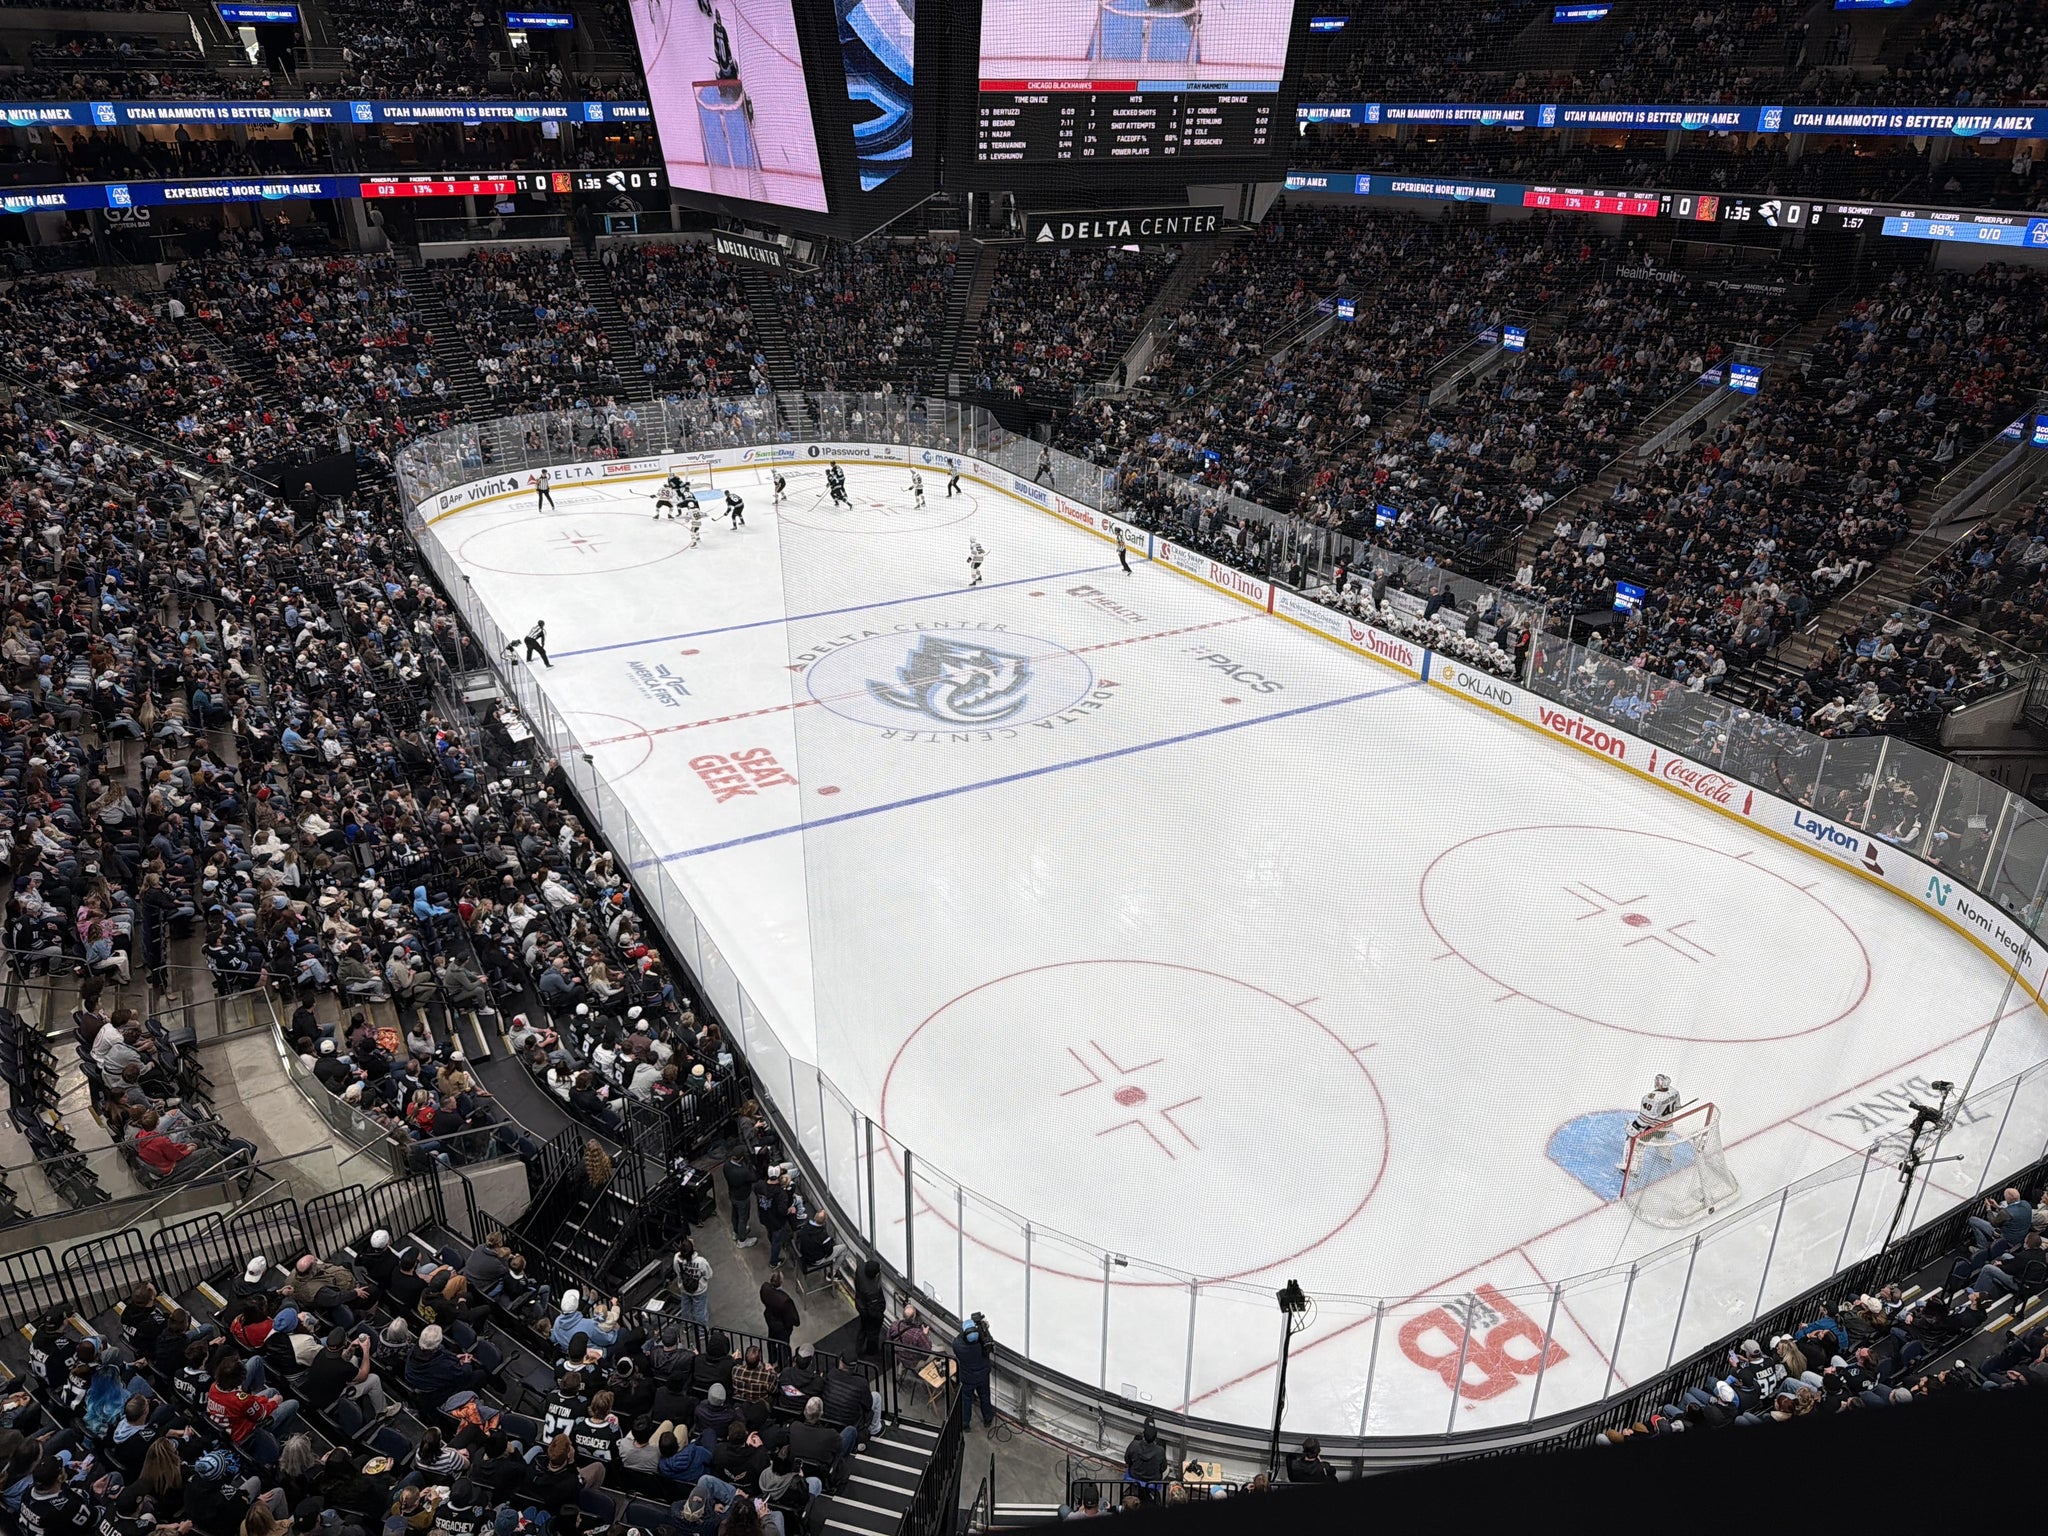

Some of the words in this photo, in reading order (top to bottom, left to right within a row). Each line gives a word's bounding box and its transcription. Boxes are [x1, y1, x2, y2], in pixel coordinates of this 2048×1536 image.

[8, 109, 38, 120] WITH
[40, 109, 72, 120] AMEX
[127, 108, 156, 119] UTAH
[158, 108, 215, 119] MAMMOTH
[218, 108, 229, 118] IS
[232, 108, 271, 118] BETTER
[273, 108, 301, 118] WITH
[303, 108, 332, 118] AMEX
[383, 108, 410, 117] UTAH
[413, 108, 463, 117] MAMMOTH
[466, 108, 476, 117] IS
[479, 108, 513, 117] BETTER
[515, 108, 539, 117] WITH
[542, 108, 568, 117] AMEX
[613, 108, 636, 117] UTAH
[1310, 109, 1328, 117] WITH
[1330, 109, 1351, 118] AMEX
[1387, 109, 1406, 118] UTAH
[1407, 109, 1444, 119] MAMMOTH
[1446, 109, 1453, 118] IS
[1455, 110, 1481, 119] BETTER
[1482, 110, 1501, 120] WITH
[1503, 110, 1524, 120] AMEX
[1565, 111, 1586, 122] UTAH
[1588, 112, 1633, 122] MAMMOTH
[1635, 112, 1645, 122] IS
[1648, 112, 1682, 123] BETTER
[1684, 113, 1709, 123] WITH
[1711, 113, 1740, 124] AMEX
[1793, 114, 1823, 126] UTAH
[1825, 115, 1887, 127] MAMMOTH
[1889, 115, 1902, 127] IS
[1905, 116, 1953, 128] BETTER
[1957, 116, 1992, 129] WITH
[1993, 117, 2034, 130] AMEX
[518, 181, 528, 190] 11
[536, 176, 546, 190] 0
[578, 179, 601, 189] 1:35
[631, 174, 641, 187] 0
[650, 179, 657, 187] 8
[1287, 177, 1306, 186] WITH
[1307, 177, 1327, 187] AMEX
[164, 187, 229, 198] EXPERIENCE
[232, 186, 261, 196] MORE
[263, 184, 290, 194] WITH
[293, 184, 322, 194] AMEX
[378, 186, 395, 194] 0/3
[413, 185, 432, 194] 13%
[448, 185, 454, 193] 3
[494, 184, 504, 192] 17
[1392, 182, 1433, 193] EXPERIENCE
[1435, 184, 1454, 194] MORE
[1456, 186, 1474, 196] WITH
[1475, 187, 1496, 198] AMEX
[5, 196, 34, 207] WITH
[36, 194, 66, 205] AMEX
[1537, 197, 1550, 205] 0/3
[1566, 198, 1581, 207] 13%
[1594, 200, 1600, 209] 3
[1617, 202, 1623, 211] 2
[1679, 198, 1691, 215] 0
[104, 206, 150, 222] G2G
[1637, 203, 1647, 212] 17
[1661, 203, 1669, 213] 11
[1724, 206, 1751, 220] 1:35
[1787, 206, 1800, 223] 0
[1812, 214, 1819, 224] 8
[1931, 213, 1960, 221] FACEOFFS
[1061, 220, 1131, 240] DELTA
[1140, 216, 1216, 234] CENTER
[1842, 217, 1864, 228] 1:57
[1900, 222, 1908, 232] 3
[1929, 225, 1954, 236] 88%
[1979, 229, 2000, 240] 0/0
[723, 238, 750, 260] DELTA
[749, 245, 780, 268] CENTER
[822, 447, 870, 457] 1Password
[935, 455, 962, 466] moie
[607, 464, 631, 472] SME
[1014, 480, 1027, 495] BUD
[1028, 486, 1047, 503] LIGHT
[448, 493, 463, 505] App
[1060, 501, 1094, 526] Trucordia
[1109, 522, 1123, 537] Kn
[1124, 528, 1145, 547] Garff
[797, 630, 880, 662] DELTA
[893, 621, 1009, 632] CENTER
[1367, 630, 1413, 667] Smith's
[1196, 654, 1284, 694] PACS
[626, 660, 660, 689] AMERICA
[652, 686, 681, 707] FIRST
[1458, 672, 1512, 706] OKLAND
[1032, 690, 1114, 730] DELTA
[881, 728, 1018, 743] CENTER
[1540, 706, 1626, 759] verizon
[730, 747, 799, 788] SEAT
[688, 754, 758, 804] GEEK
[1793, 811, 1859, 852] Layton
[1957, 898, 1994, 933] Nomi
[1995, 926, 2032, 968] Health
[247, 1401, 260, 1415] 98
[548, 1403, 572, 1417] HAYTON
[543, 1417, 575, 1444] 27
[575, 1435, 610, 1449] SERGACHEV
[72, 1504, 91, 1526] 67
[435, 1517, 475, 1533] SERGACHEV
